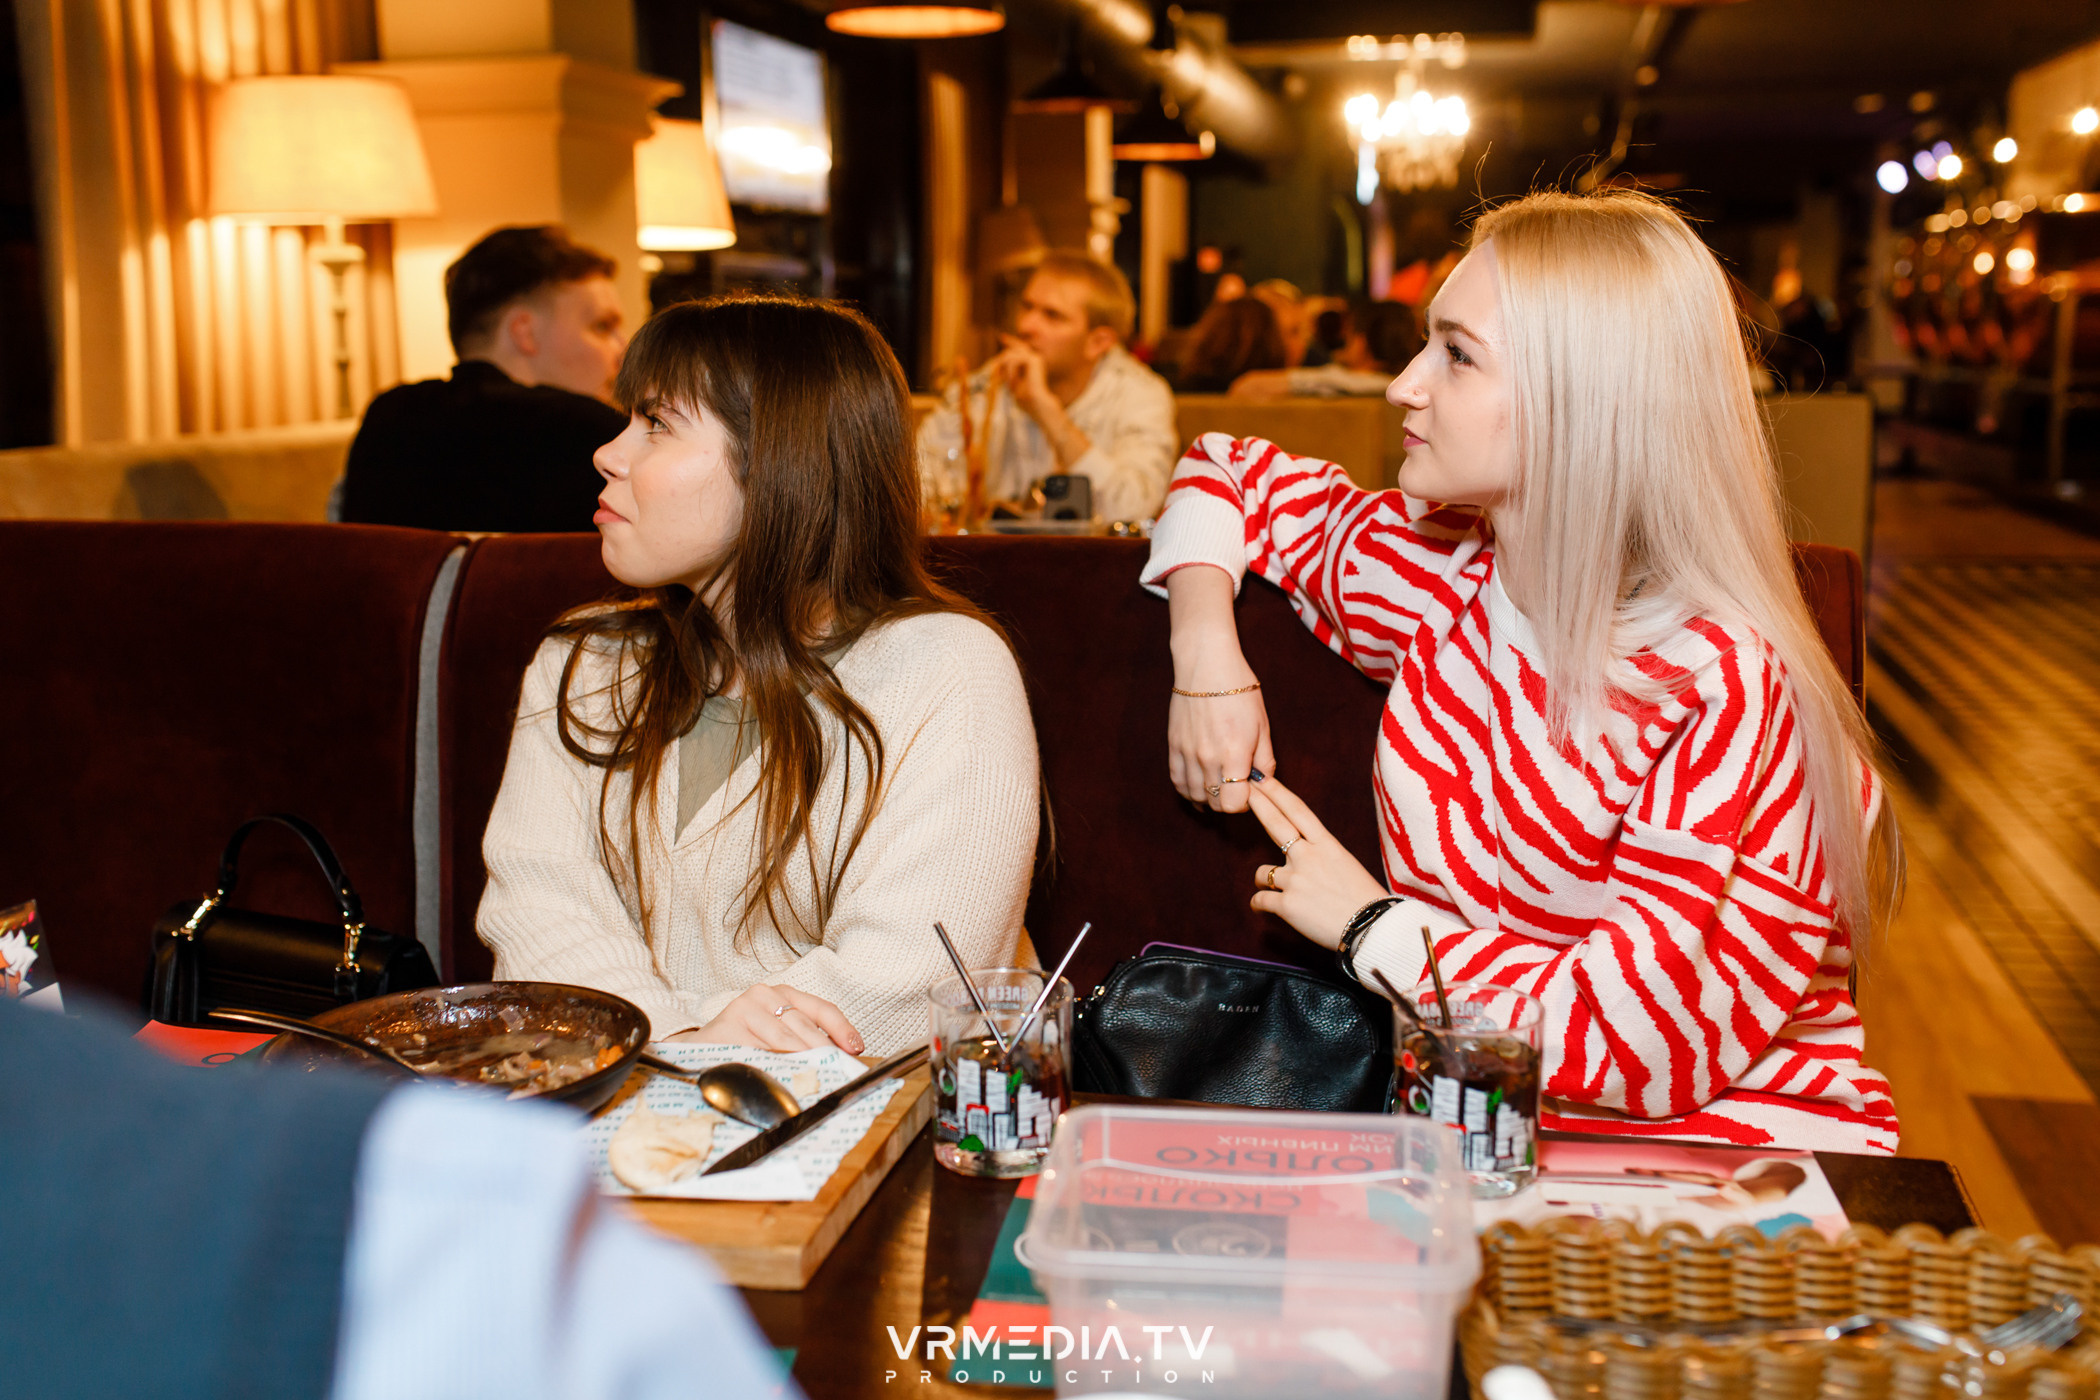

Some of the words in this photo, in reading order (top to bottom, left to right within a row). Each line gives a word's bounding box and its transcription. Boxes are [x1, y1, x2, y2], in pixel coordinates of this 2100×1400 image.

[1218, 1002, 1260, 1013] BADEN
[678, 1044, 743, 1056] МЮНХЕН
[1217, 1135, 1339, 1152] ПИВНЫХ
